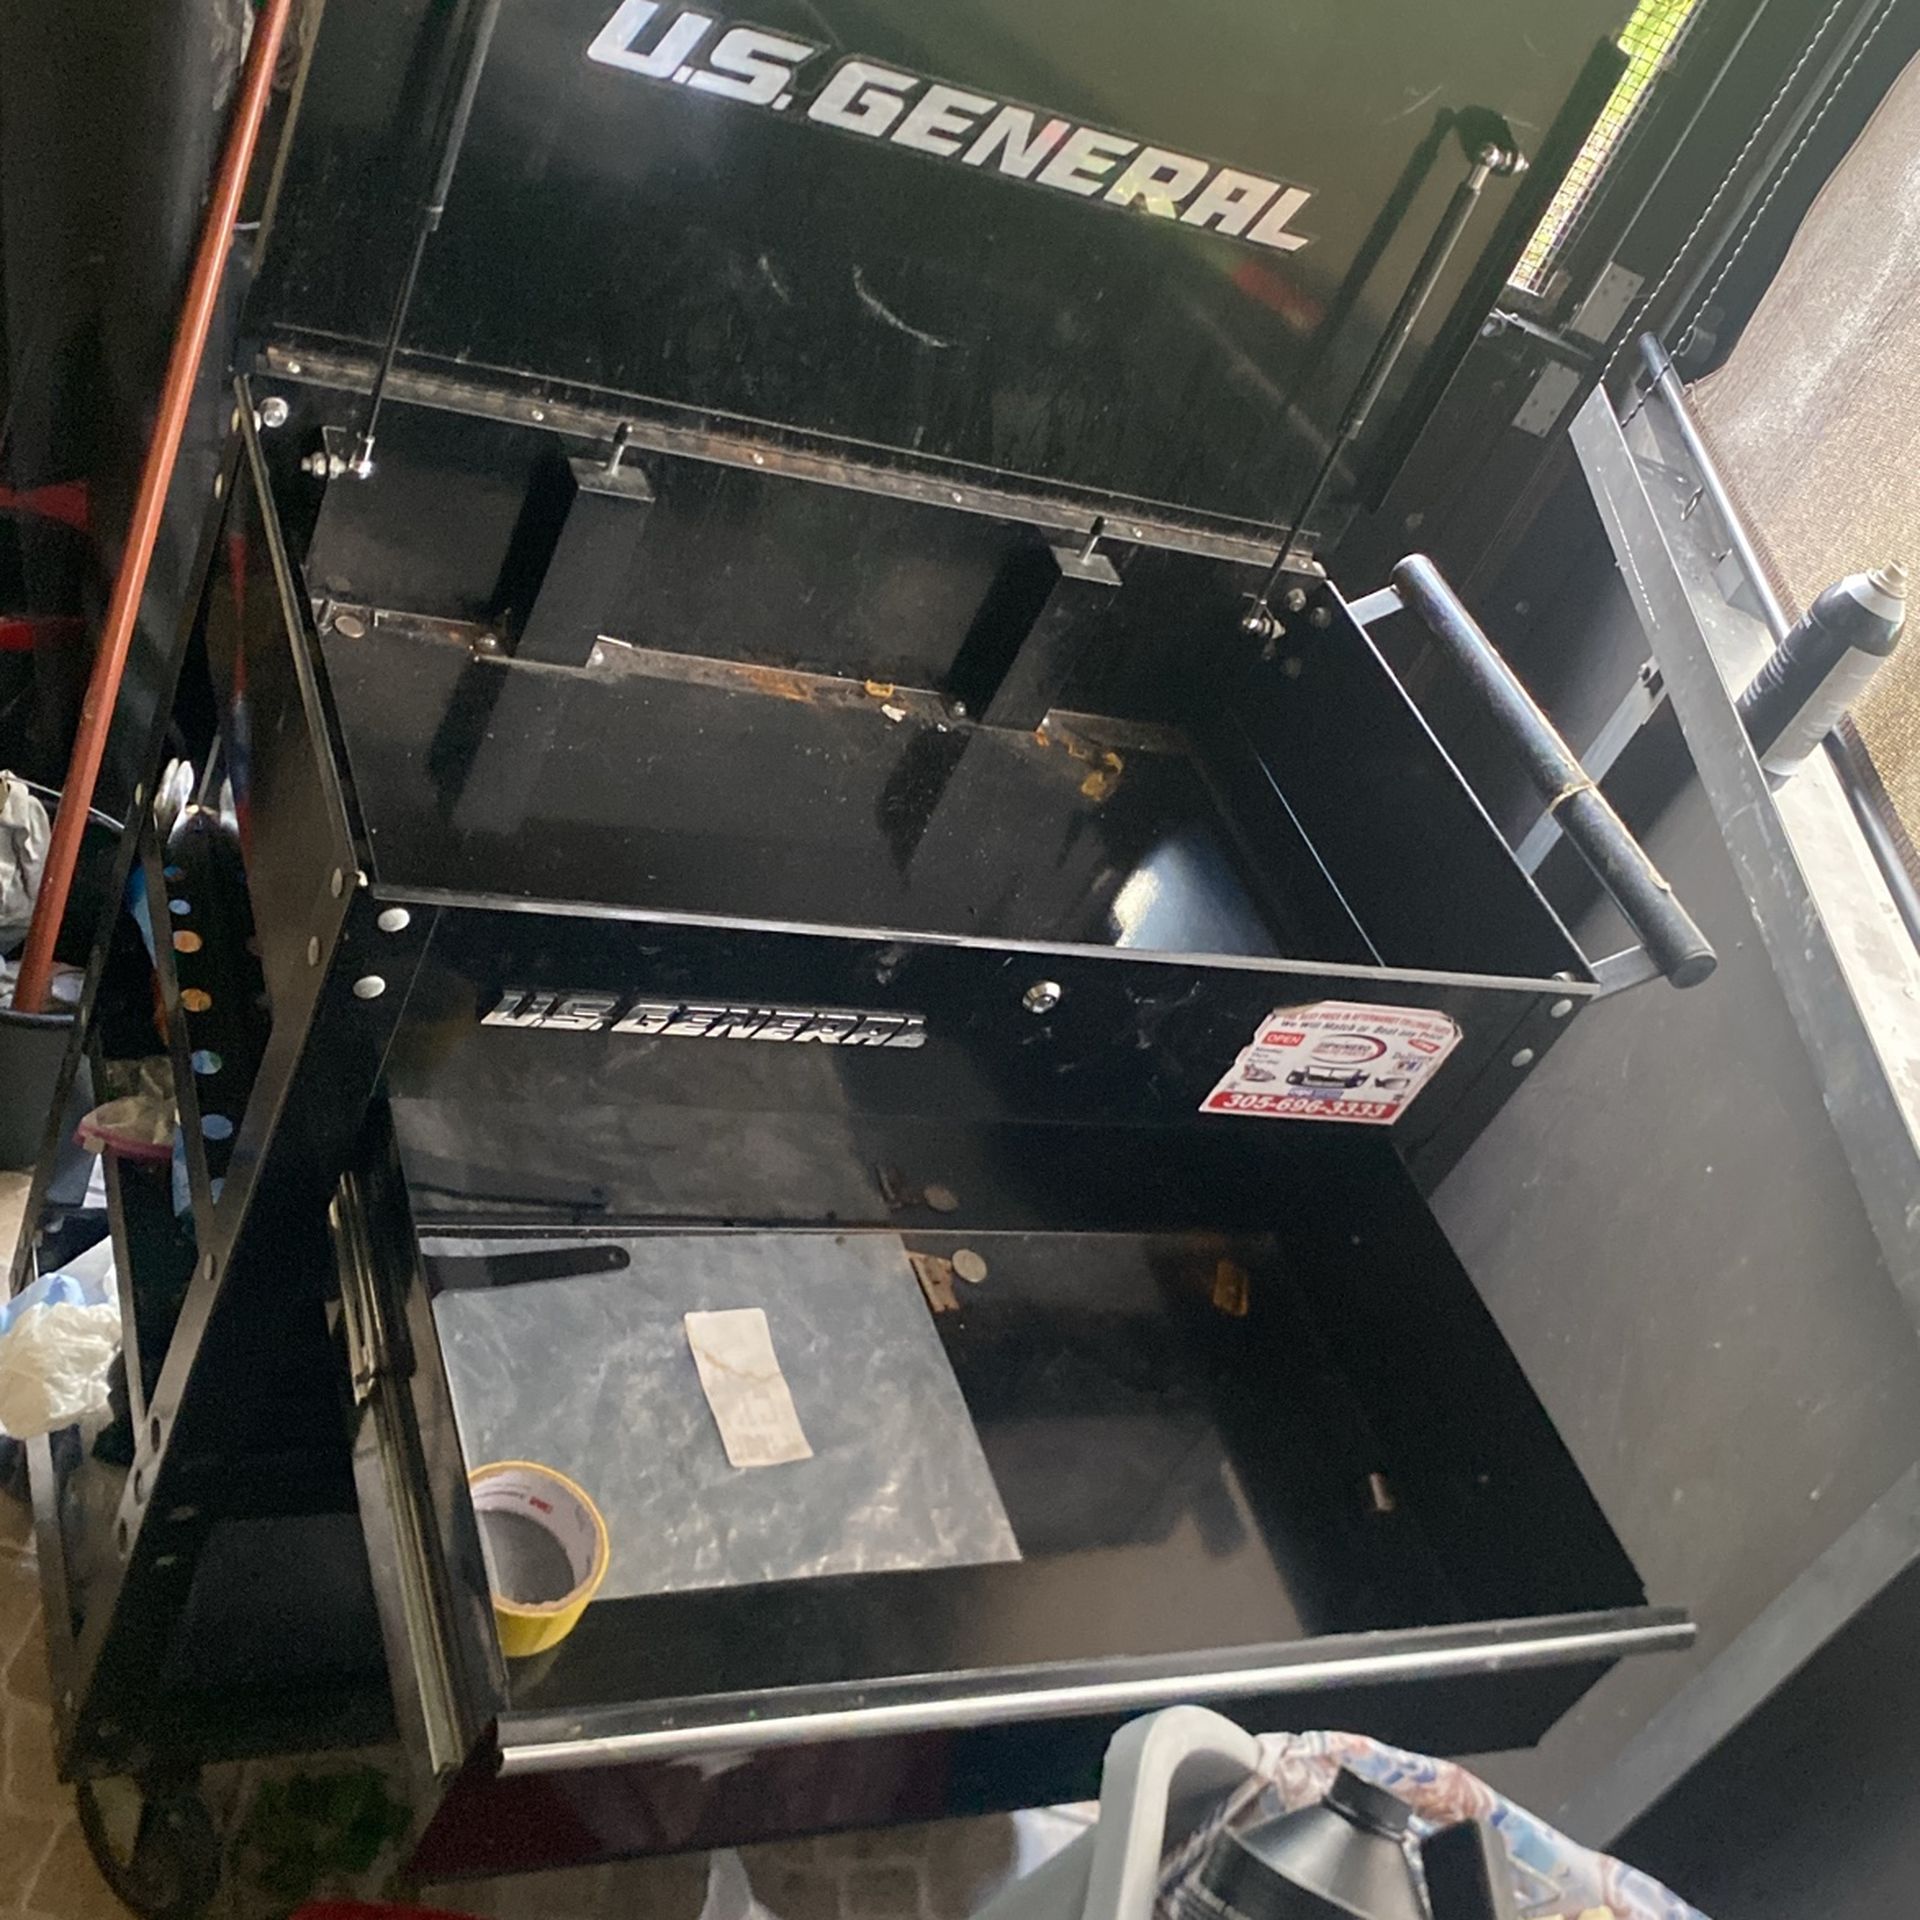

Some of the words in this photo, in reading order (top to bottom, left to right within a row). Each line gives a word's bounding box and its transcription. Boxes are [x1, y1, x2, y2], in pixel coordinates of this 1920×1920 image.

[586, 0, 815, 111] U.S.
[807, 60, 1312, 252] GENERAL
[480, 991, 617, 1031] U.S.
[611, 1002, 928, 1048] GENERAL
[1323, 1021, 1355, 1032] Match
[1373, 1025, 1398, 1036] Beat
[1265, 1033, 1301, 1045] OPEN
[1222, 1093, 1387, 1118] 305-696-3333
